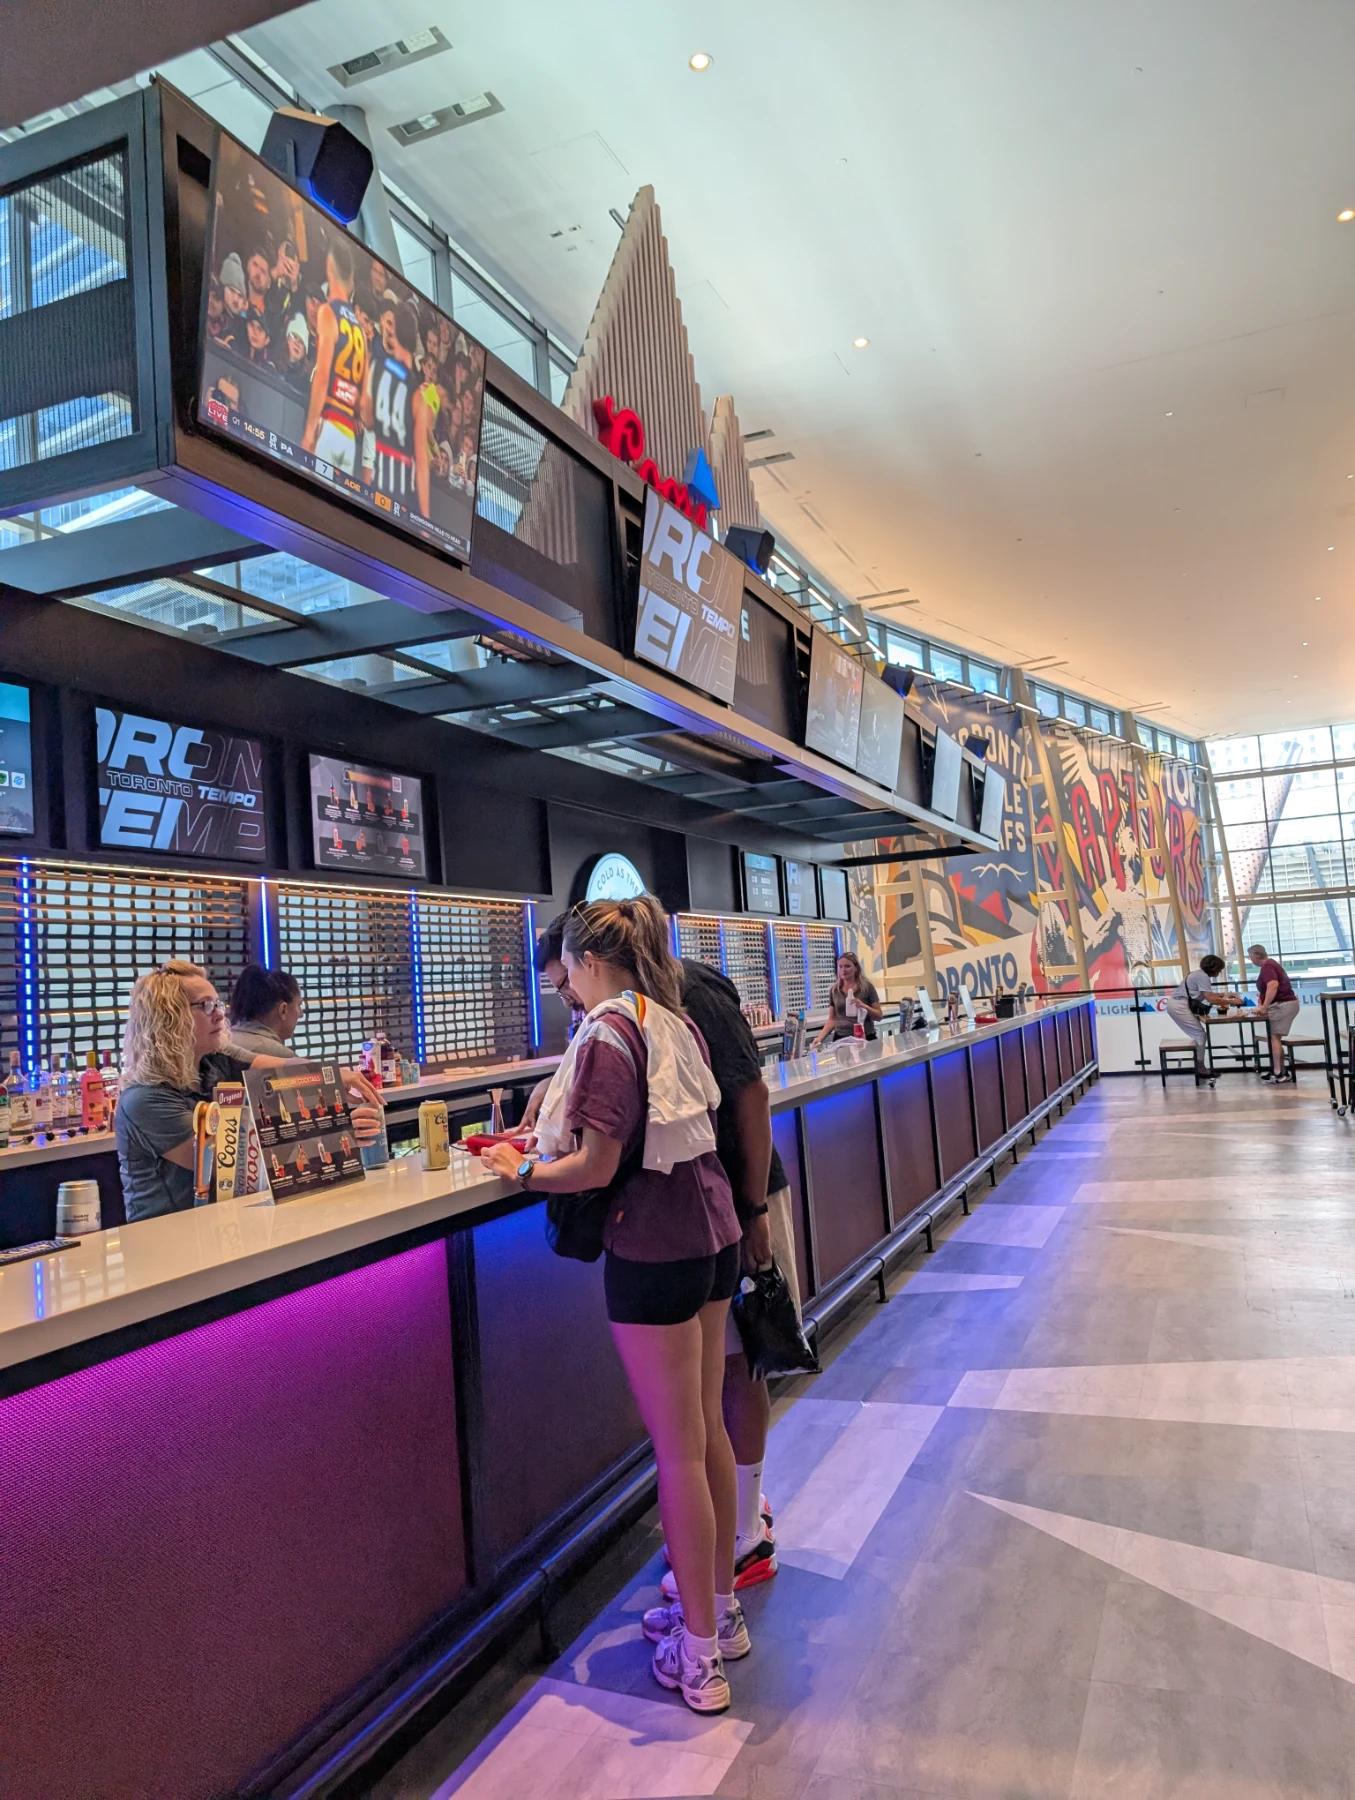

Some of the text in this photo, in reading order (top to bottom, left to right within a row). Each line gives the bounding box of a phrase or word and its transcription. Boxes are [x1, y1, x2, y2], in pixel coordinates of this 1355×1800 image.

[335, 318, 365, 384] 28
[207, 406, 229, 424] LIVE
[375, 370, 408, 447] 44
[243, 421, 266, 440] 14:55
[321, 464, 328, 474] 7
[701, 604, 736, 639] TEMPO
[107, 770, 257, 808] TORONTO TEMPO
[597, 867, 614, 891] COLD
[616, 866, 625, 879] AS
[935, 952, 1018, 1007] ORONTO
[219, 1091, 243, 1105] Original
[217, 1116, 239, 1169] Coors
